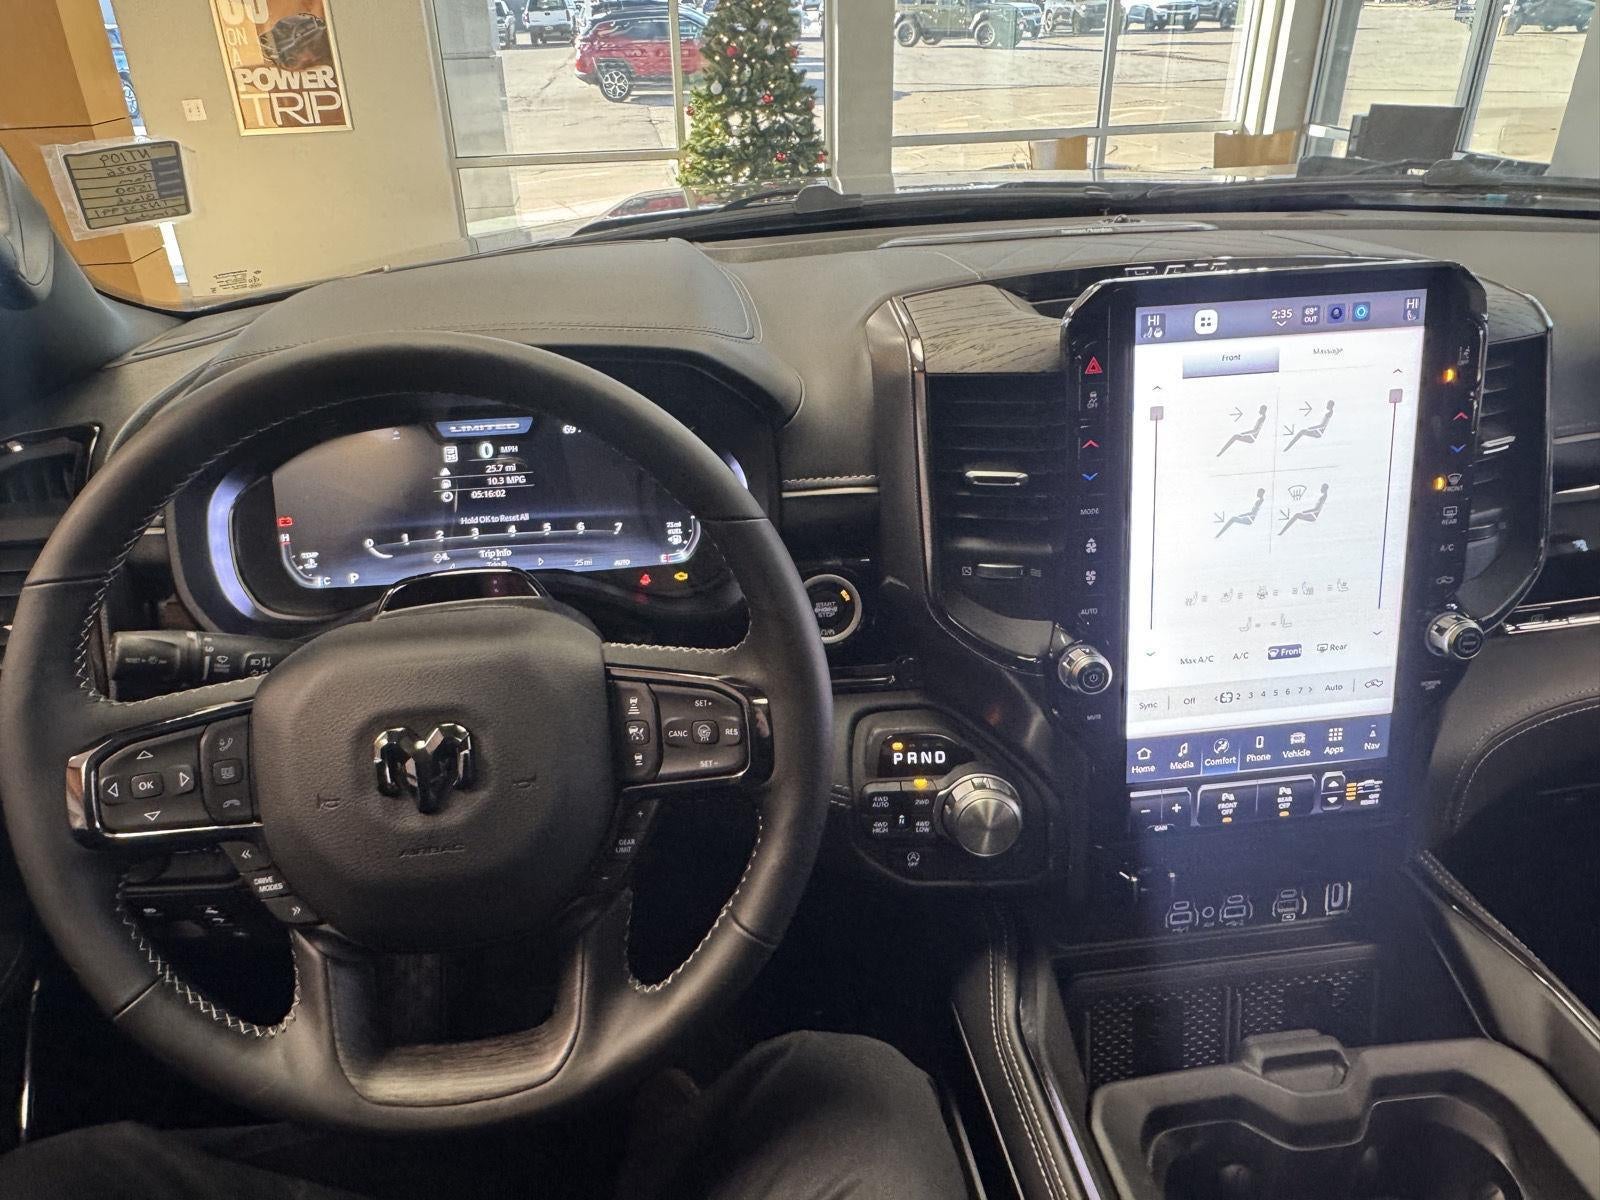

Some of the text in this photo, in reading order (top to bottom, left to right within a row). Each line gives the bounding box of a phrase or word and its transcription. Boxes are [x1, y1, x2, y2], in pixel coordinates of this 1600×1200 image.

[225, 27, 248, 46] ON
[229, 48, 242, 66] A
[232, 65, 337, 91] POWER
[240, 90, 342, 126] TRIP
[1406, 298, 1419, 309] HI
[1271, 309, 1293, 320] 2:35
[1147, 315, 1160, 326] HI
[1221, 354, 1241, 362] Front
[449, 422, 520, 433] LIMITED
[479, 442, 519, 459] 0 MPH
[485, 463, 517, 473] 25.7 mi
[487, 475, 527, 485] 10.3 MPG
[471, 489, 506, 499] 05:16:02
[461, 516, 479, 524] Hold
[479, 514, 491, 522] OK
[471, 527, 480, 537] 3
[479, 548, 512, 558] Trip Info
[349, 573, 359, 584] P
[1280, 647, 1302, 657] Front
[1329, 643, 1348, 652] Rear
[1197, 655, 1215, 664] A/C
[1232, 652, 1249, 660] A/C
[1324, 683, 1344, 692] Auto
[1139, 701, 1158, 710] Sync
[1183, 697, 1197, 705] Off
[668, 730, 688, 738] CANC
[725, 728, 739, 736] RES
[1323, 745, 1345, 755] Apps
[1364, 742, 1381, 751] Nav
[1246, 753, 1272, 763] Phone
[1282, 749, 1311, 759] Vehicle
[1170, 760, 1195, 770] Media
[1204, 756, 1237, 767] Comfort
[1131, 765, 1156, 774] Home
[138, 780, 154, 791] OK
[253, 876, 273, 885] DRIVE
[258, 882, 284, 893] MODES
